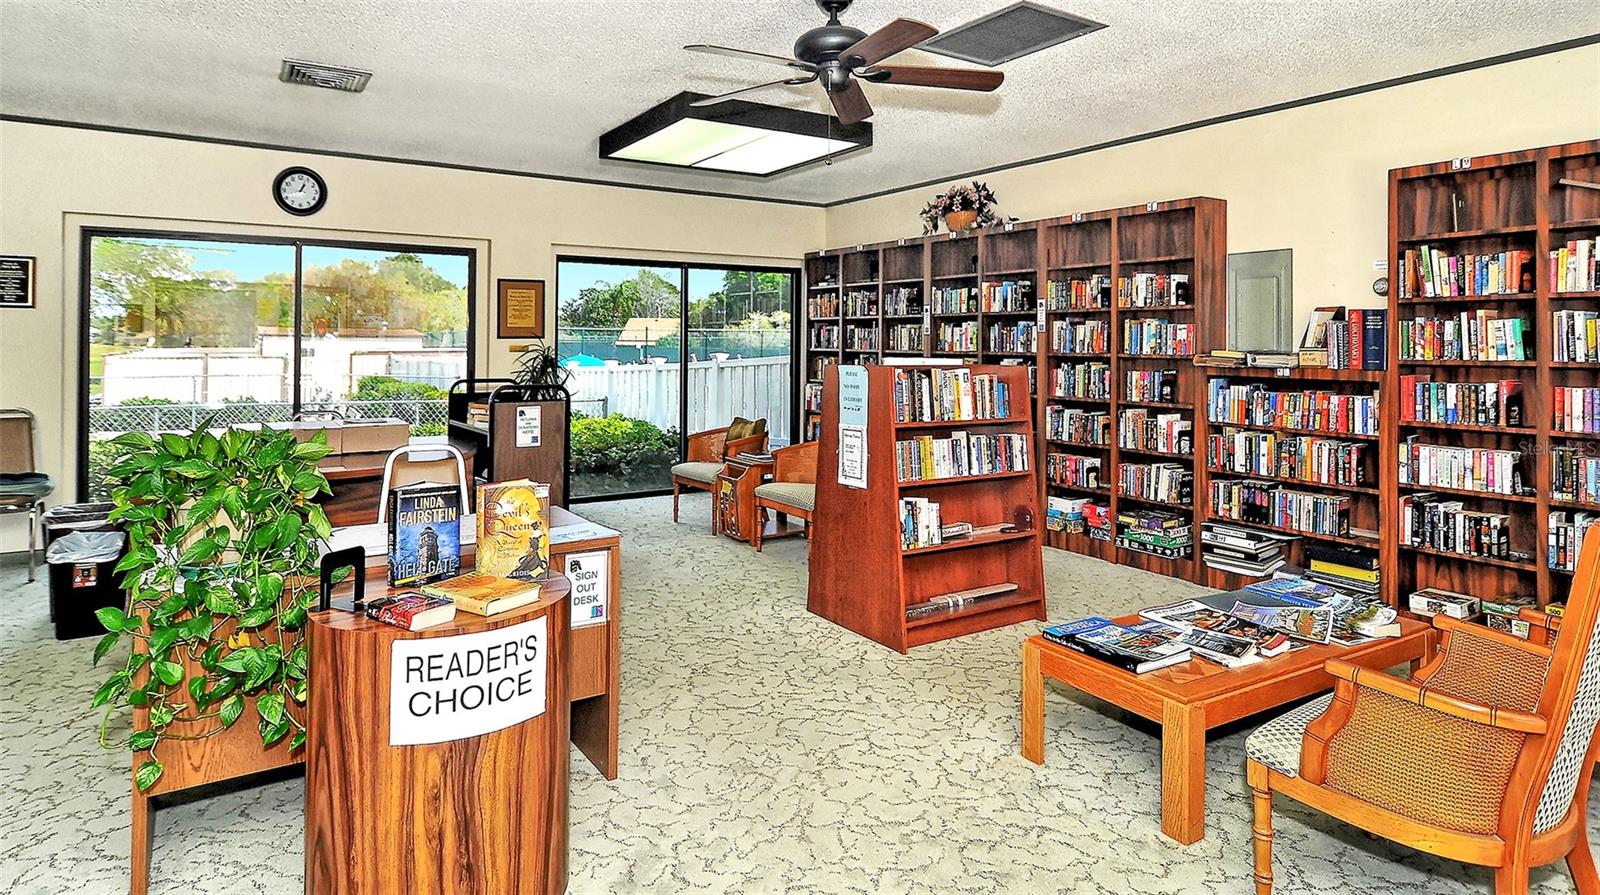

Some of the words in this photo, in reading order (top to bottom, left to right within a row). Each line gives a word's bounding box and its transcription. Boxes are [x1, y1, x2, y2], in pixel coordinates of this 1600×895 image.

[414, 496, 445, 510] LINDA
[399, 507, 457, 526] FAIRSTEIN
[486, 519, 530, 539] Queen
[428, 557, 456, 575] GATE
[575, 570, 599, 581] SIGN
[576, 582, 597, 593] OUT
[573, 594, 599, 606] DESK
[405, 634, 537, 683] READER'S
[408, 669, 533, 717] CHOICE
